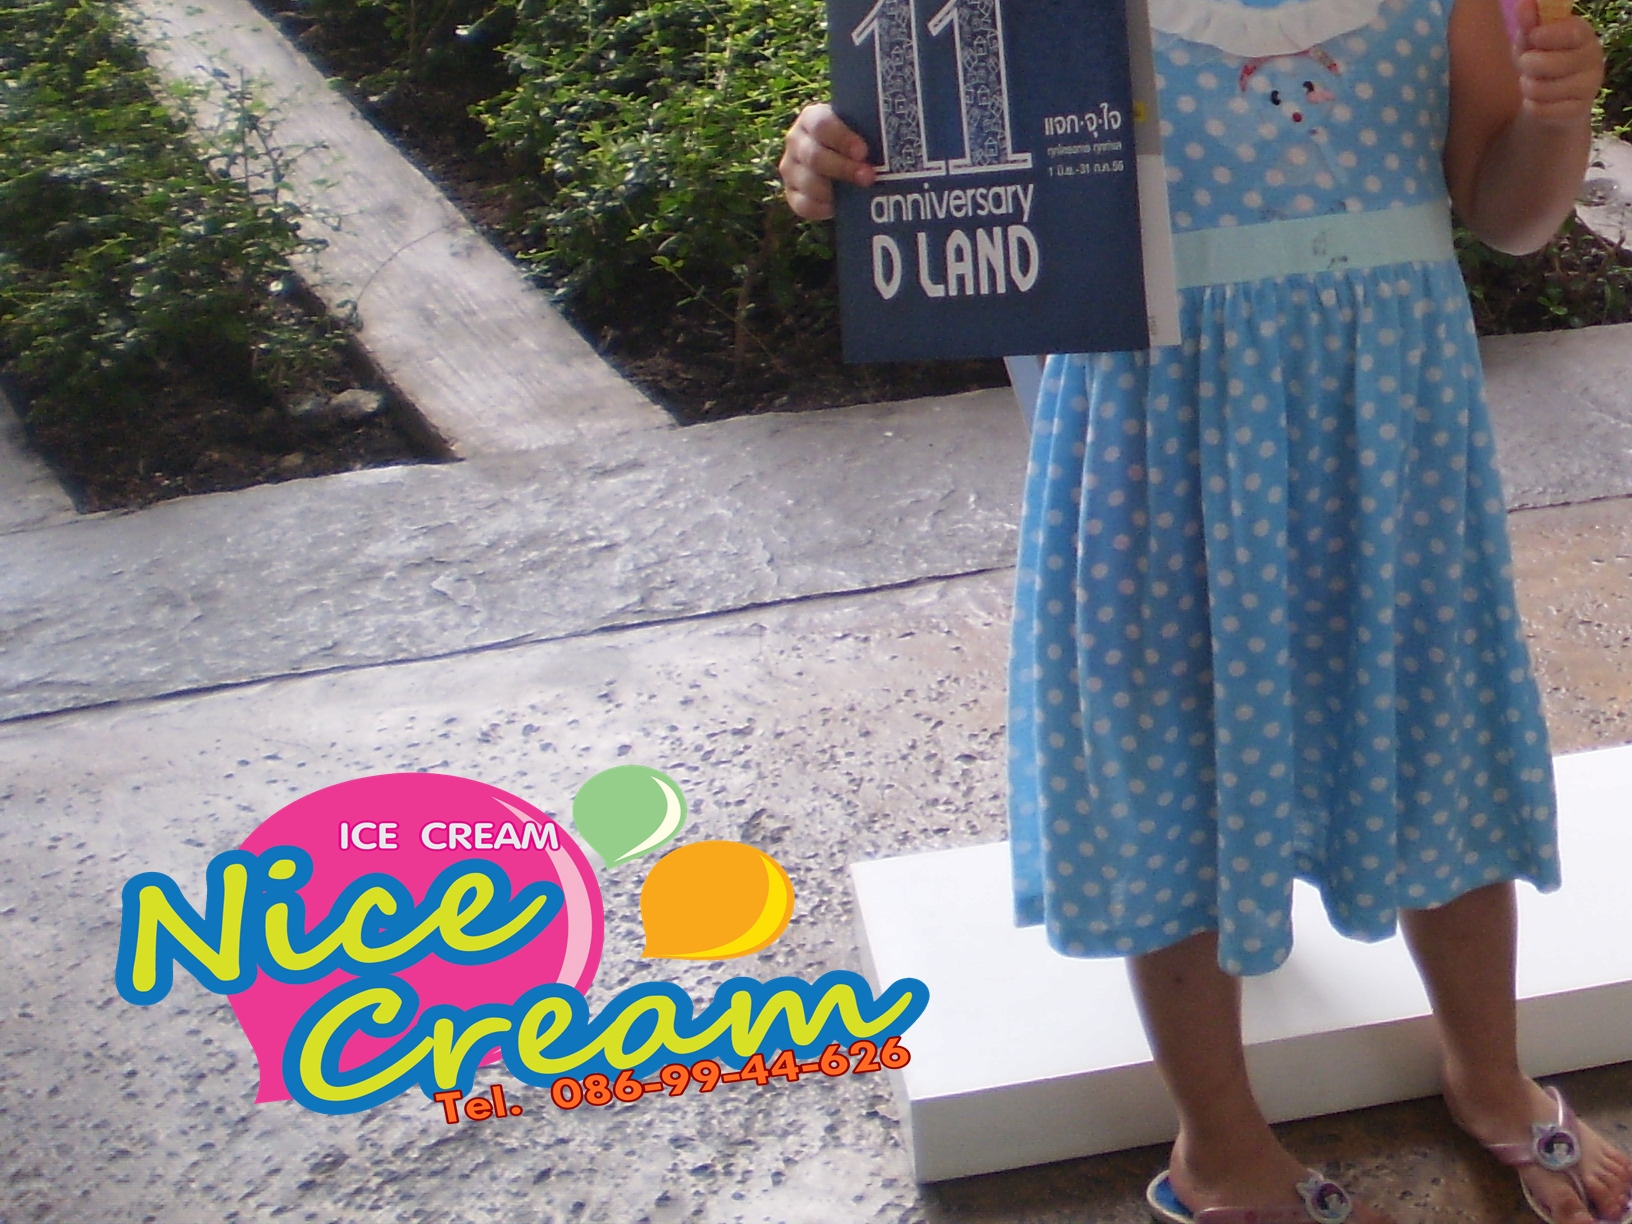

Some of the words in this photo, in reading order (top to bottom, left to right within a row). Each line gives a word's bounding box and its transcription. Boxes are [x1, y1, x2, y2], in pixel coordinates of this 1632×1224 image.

[870, 183, 1034, 223] anniversary
[872, 234, 902, 300] D
[917, 224, 1039, 298] LAND
